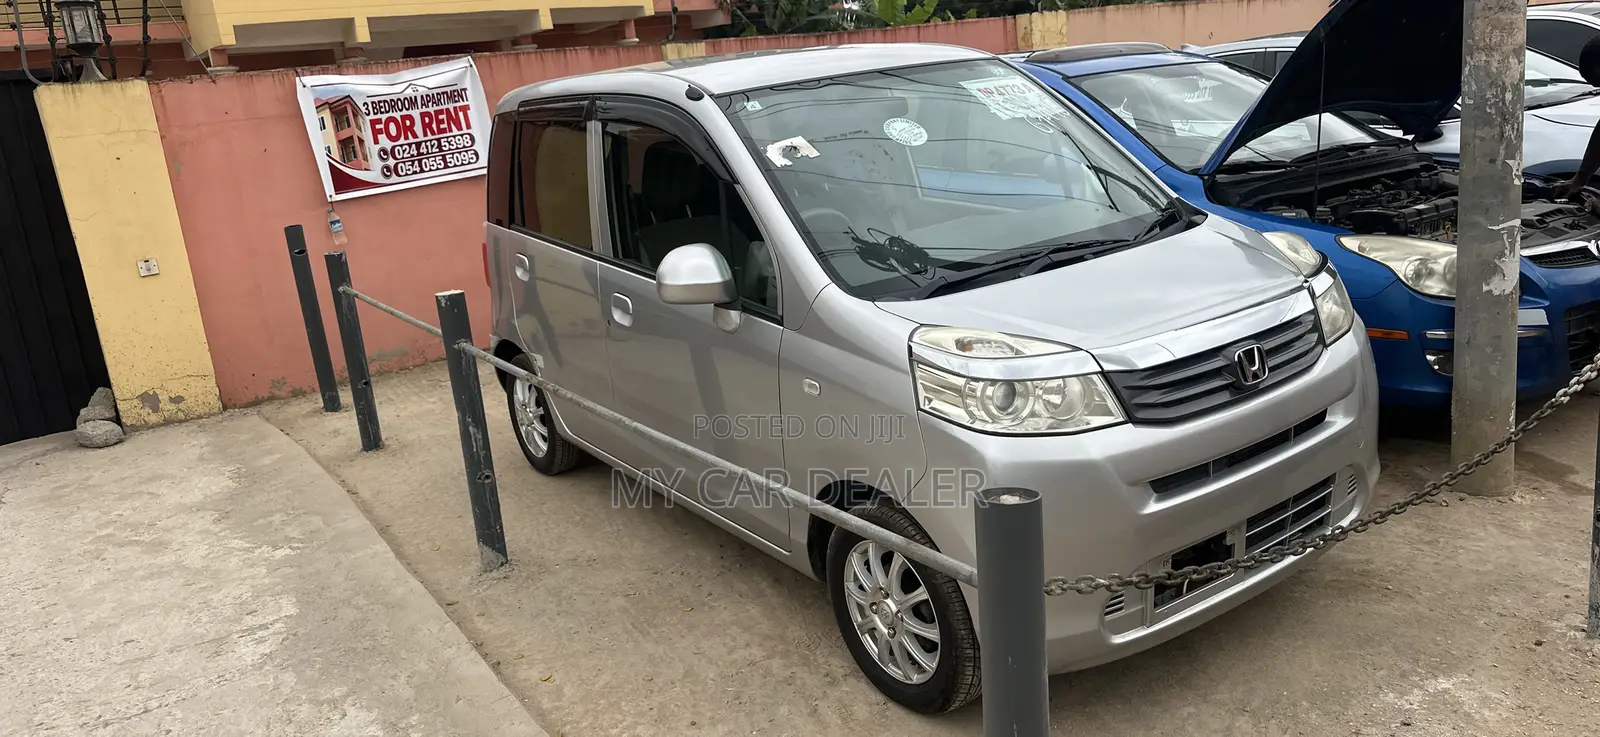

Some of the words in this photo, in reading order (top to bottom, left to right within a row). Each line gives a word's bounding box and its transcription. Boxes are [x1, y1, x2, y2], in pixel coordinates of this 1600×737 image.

[362, 102, 371, 117] 3
[372, 97, 419, 116] BEDROOM
[420, 88, 469, 109] APARTMENT
[369, 114, 420, 145] FOR
[419, 104, 472, 137] RENT
[394, 143, 418, 159] 024
[420, 140, 439, 155] 412
[440, 134, 472, 152] 5398
[398, 161, 421, 176] 054
[423, 156, 444, 172] 055
[446, 150, 477, 168] 5095
